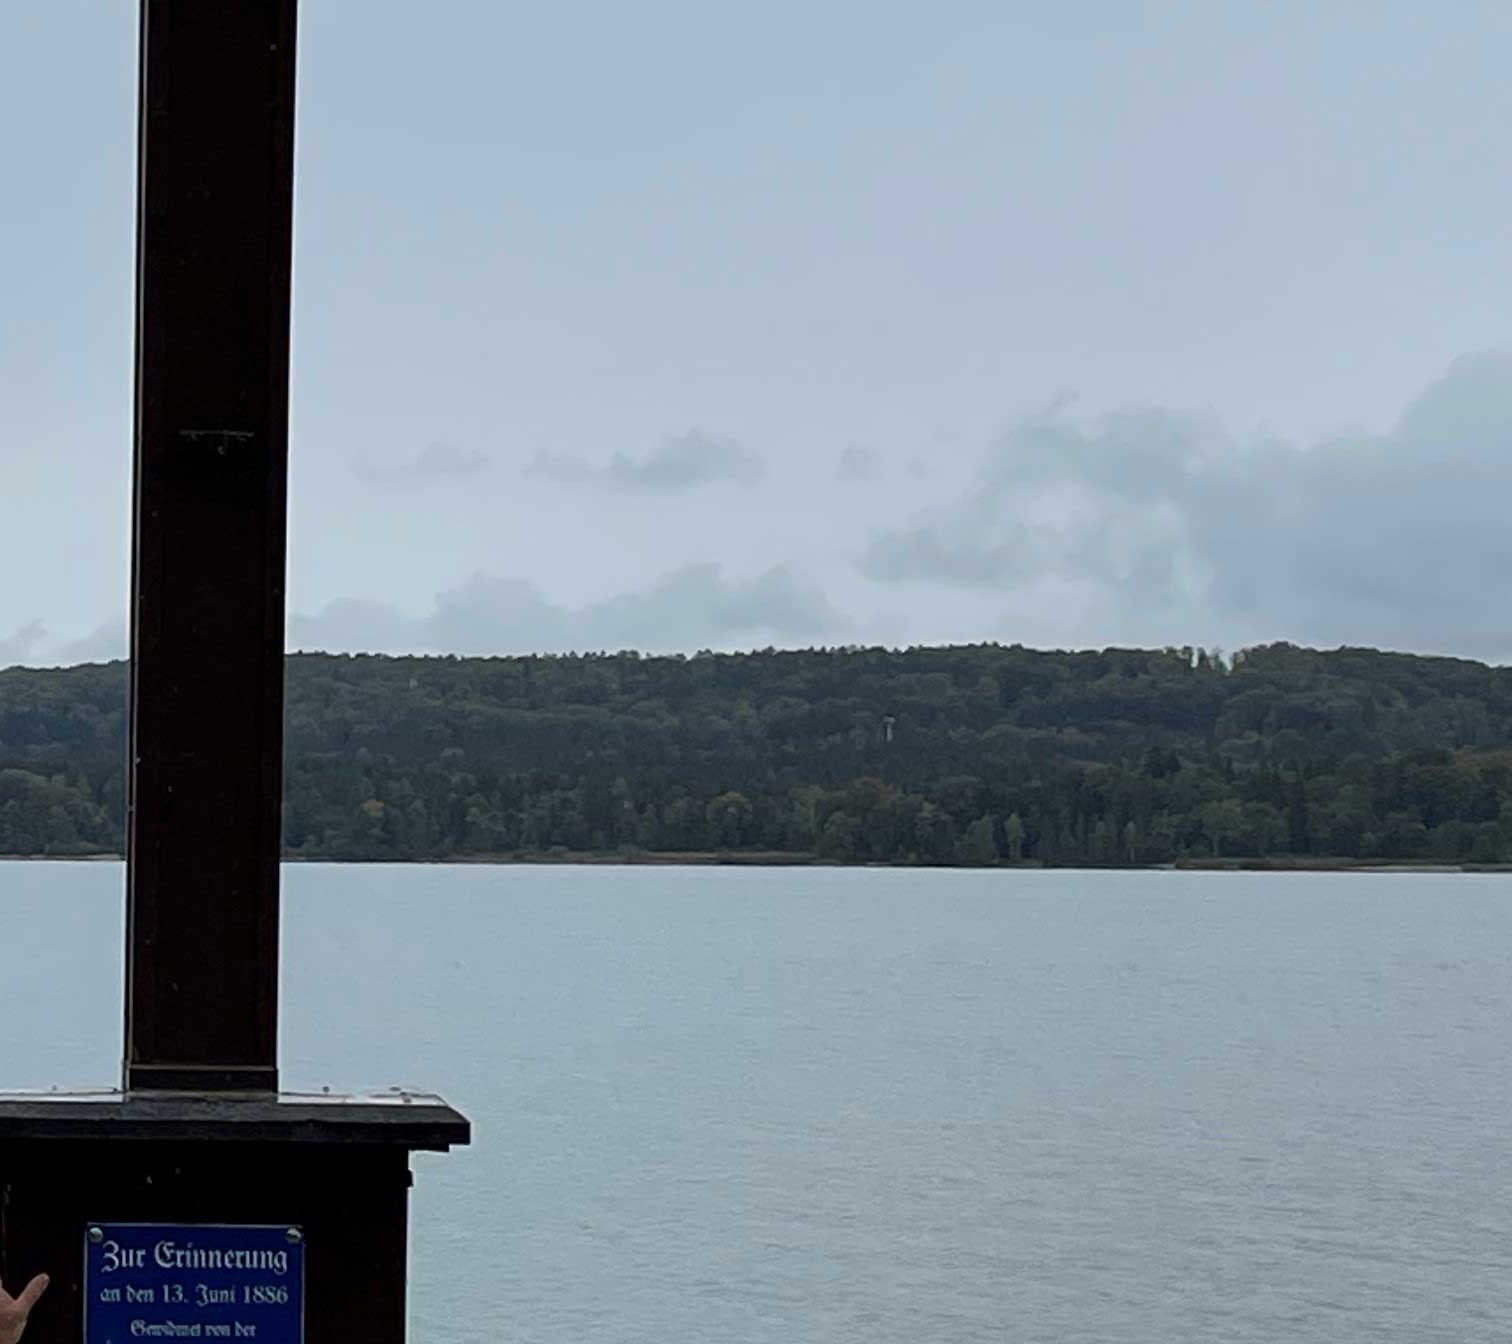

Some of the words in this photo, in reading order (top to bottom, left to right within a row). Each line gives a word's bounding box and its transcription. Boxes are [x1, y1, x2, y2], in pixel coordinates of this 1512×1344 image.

[101, 1240, 146, 1273] Zur
[154, 1241, 288, 1275] Erinnerung
[100, 1286, 121, 1303] an
[126, 1284, 155, 1303] den
[162, 1284, 189, 1303] 13.
[195, 1283, 236, 1306] Juni
[244, 1285, 289, 1304] 1886
[235, 1320, 256, 1337] der
